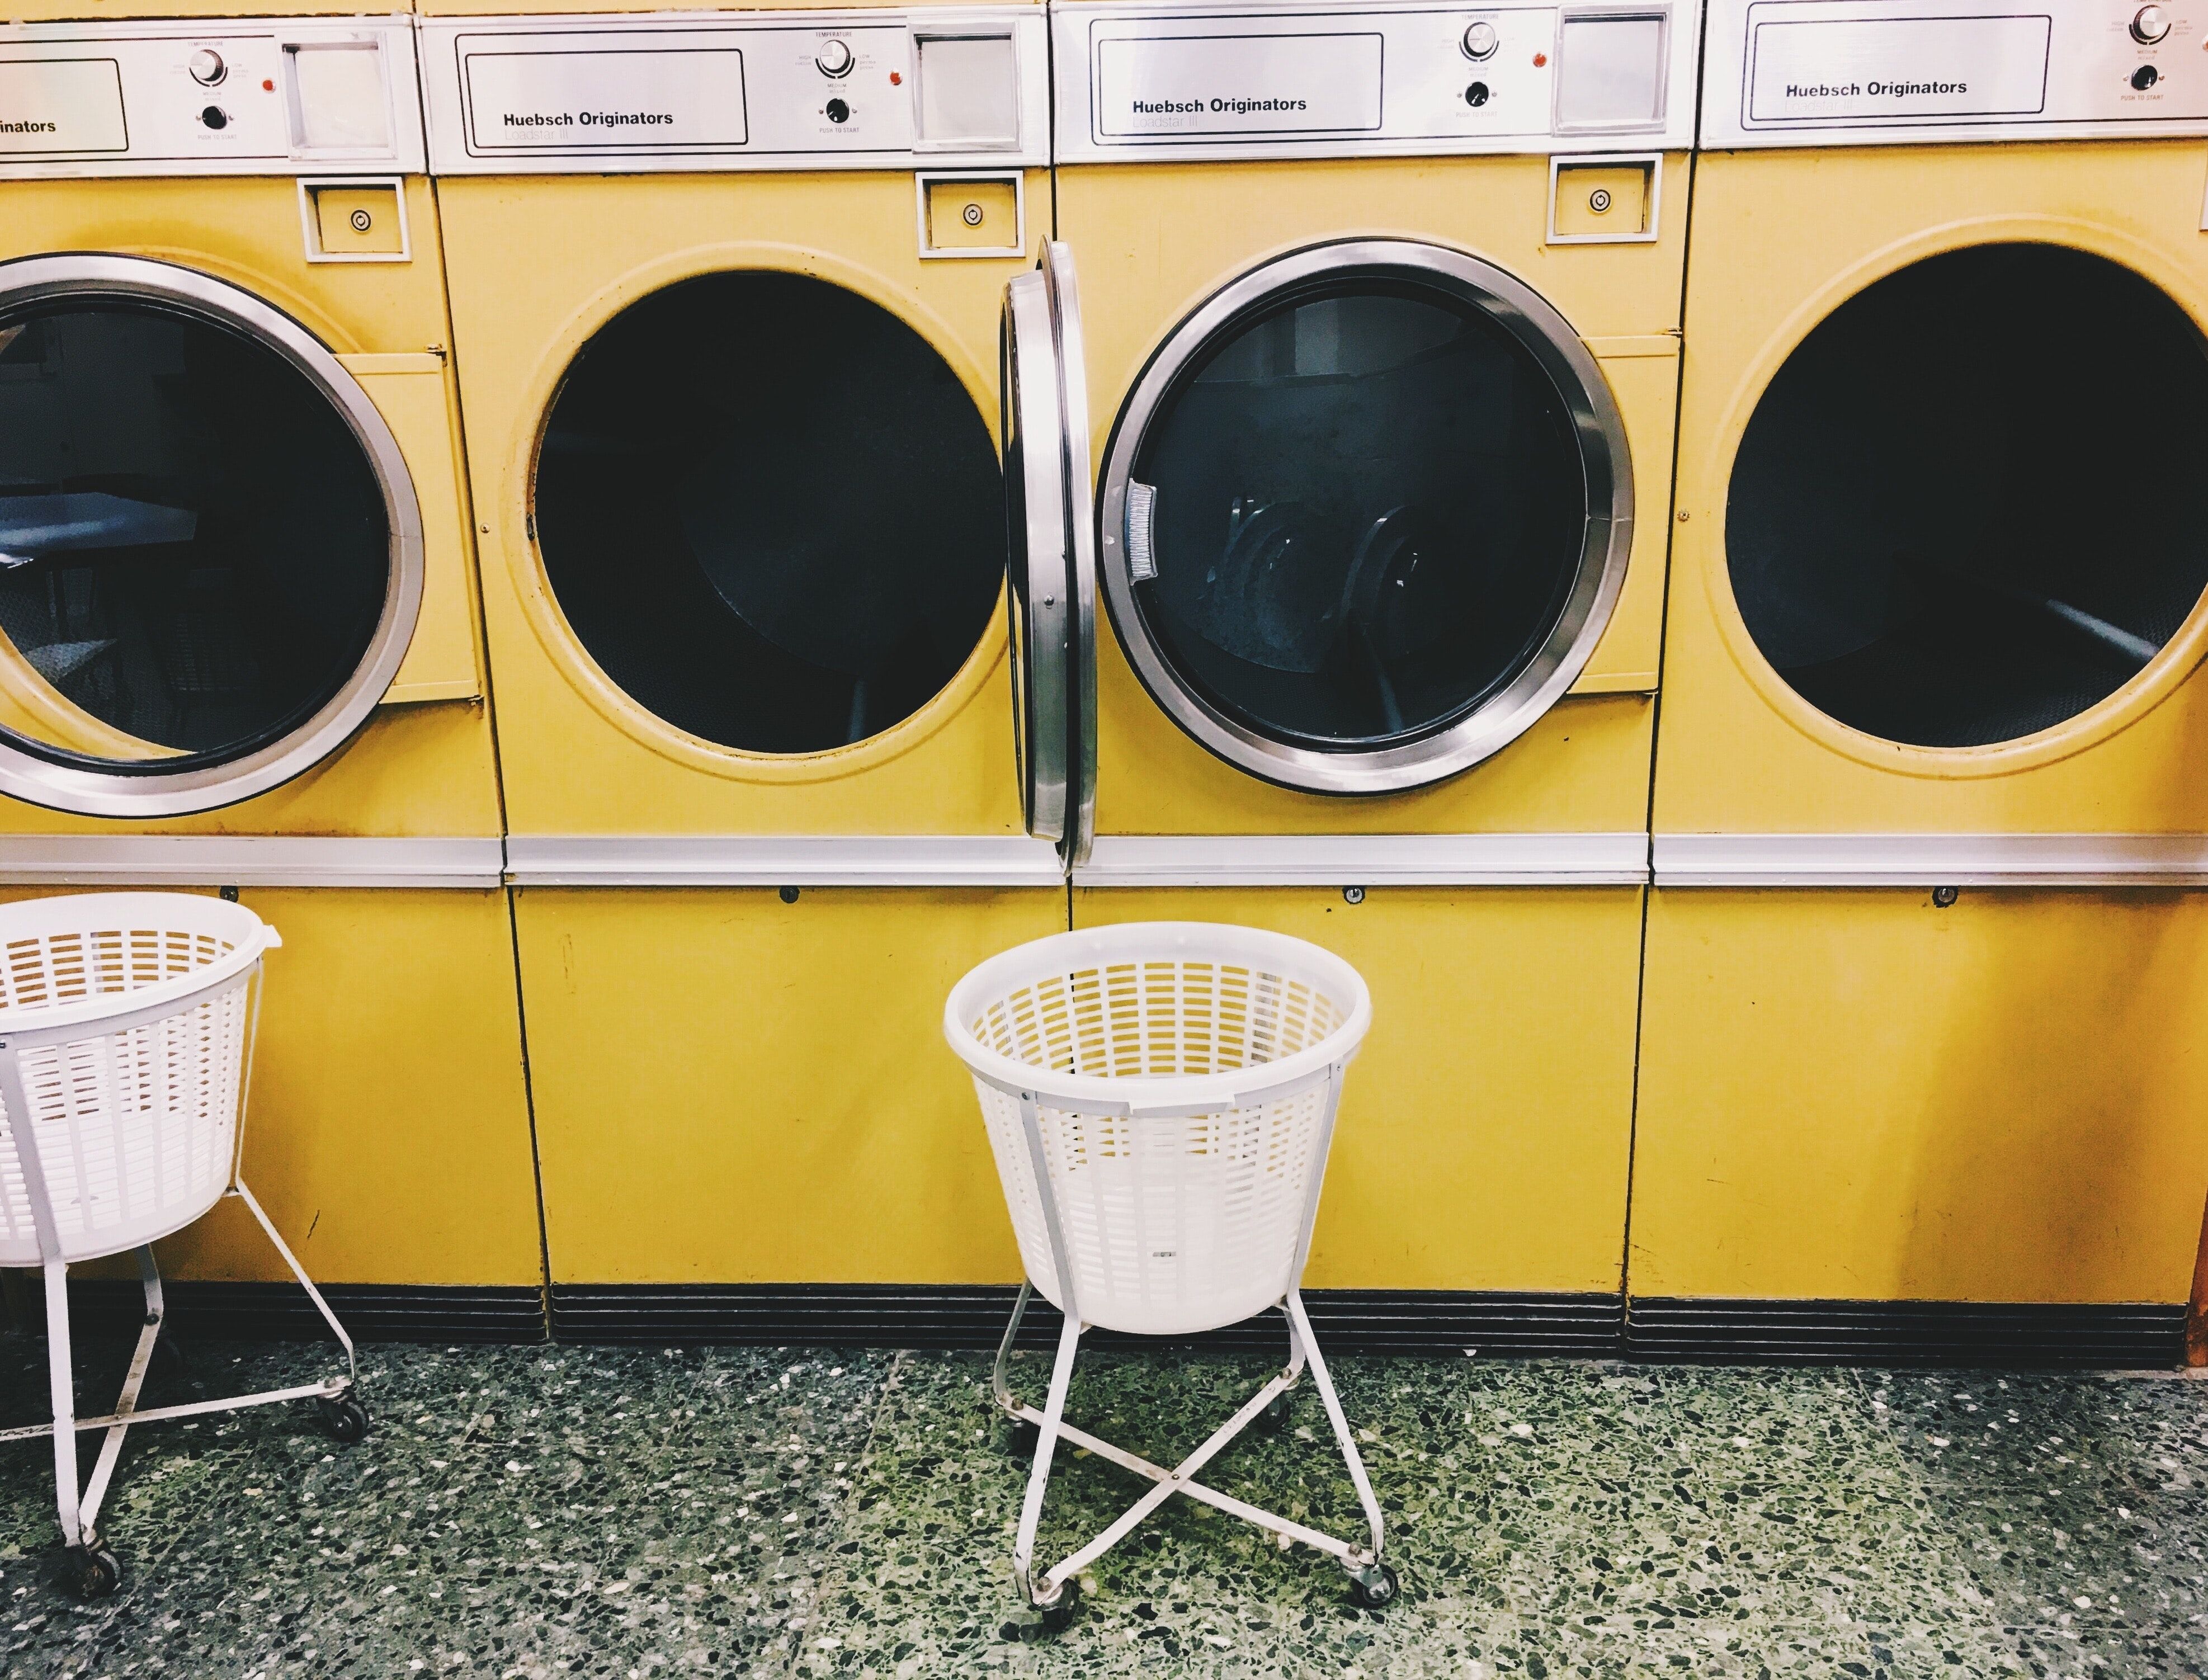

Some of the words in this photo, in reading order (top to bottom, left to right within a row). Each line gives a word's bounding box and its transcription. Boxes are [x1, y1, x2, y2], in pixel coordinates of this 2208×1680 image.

[1786, 83, 1860, 97] Huebsch
[1867, 81, 1968, 97] Originators
[1133, 99, 1204, 114] Huebsch
[1210, 98, 1307, 114] Originators
[503, 113, 573, 126] Huebsch
[579, 112, 674, 128] Originators
[1133, 116, 1184, 128] Loadstar
[504, 129, 554, 140] Loadstar
